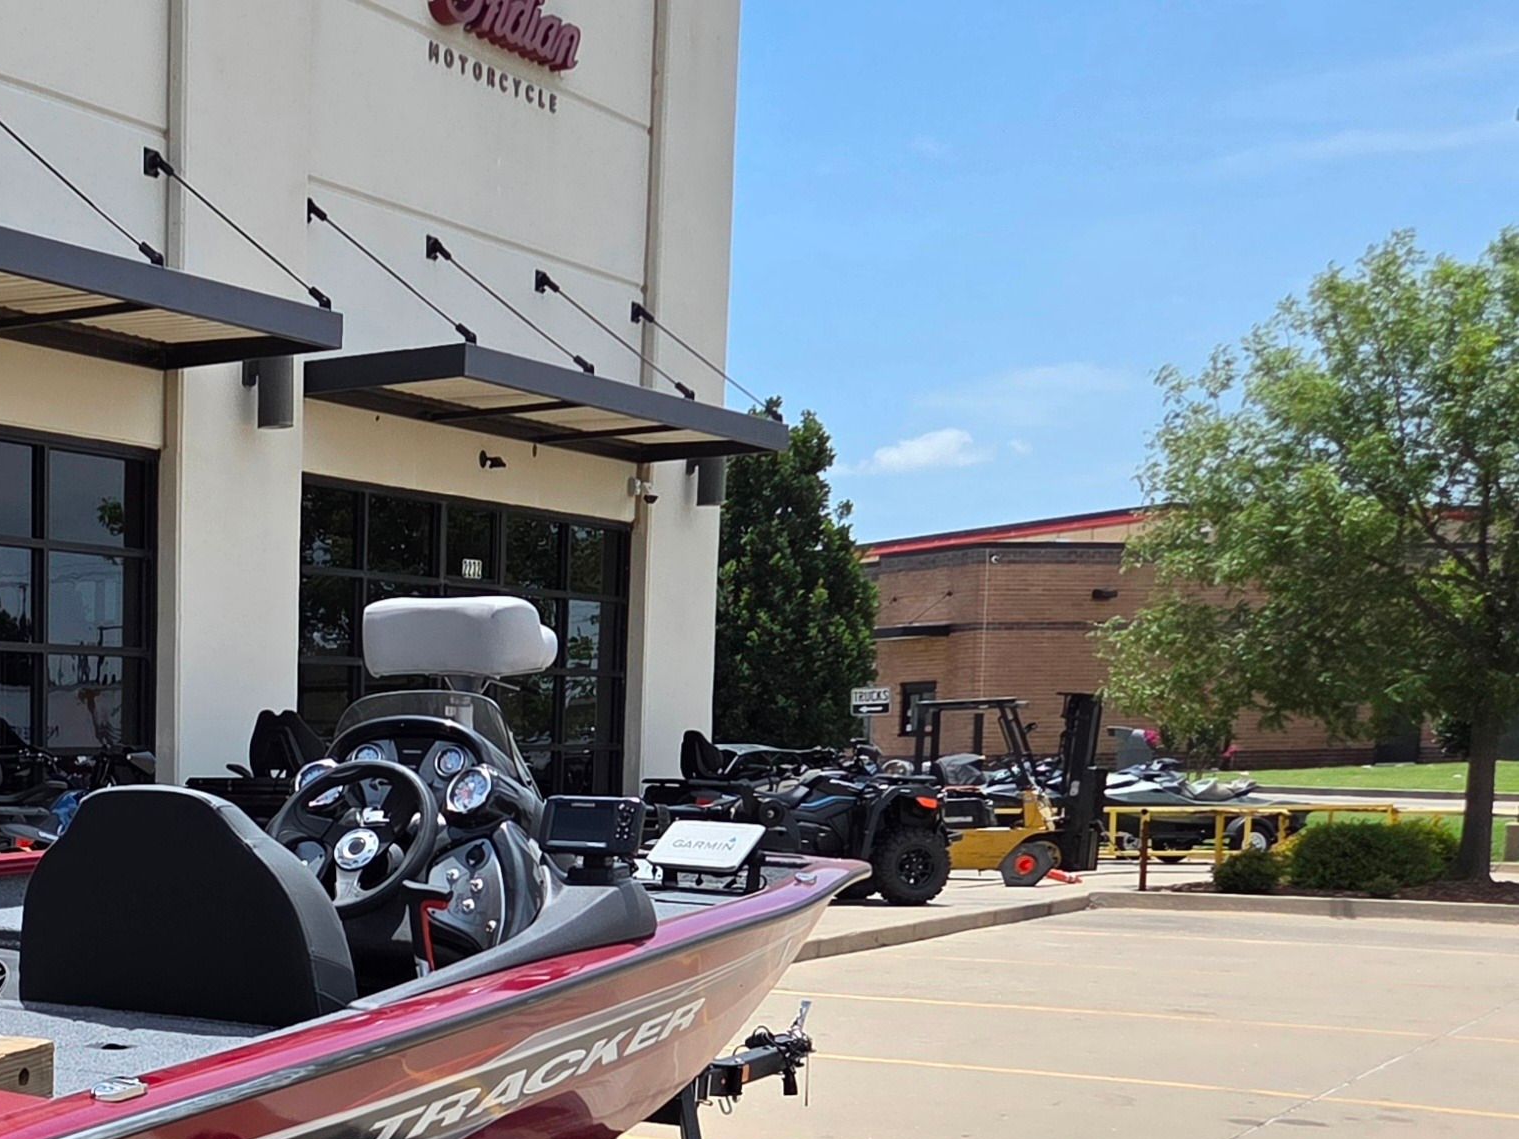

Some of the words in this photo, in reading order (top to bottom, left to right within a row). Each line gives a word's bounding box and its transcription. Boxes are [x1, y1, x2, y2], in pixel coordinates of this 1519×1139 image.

[428, 40, 558, 113] MOTORCYCLE
[854, 690, 889, 702] TRUCKS
[672, 838, 736, 851] GARMIN
